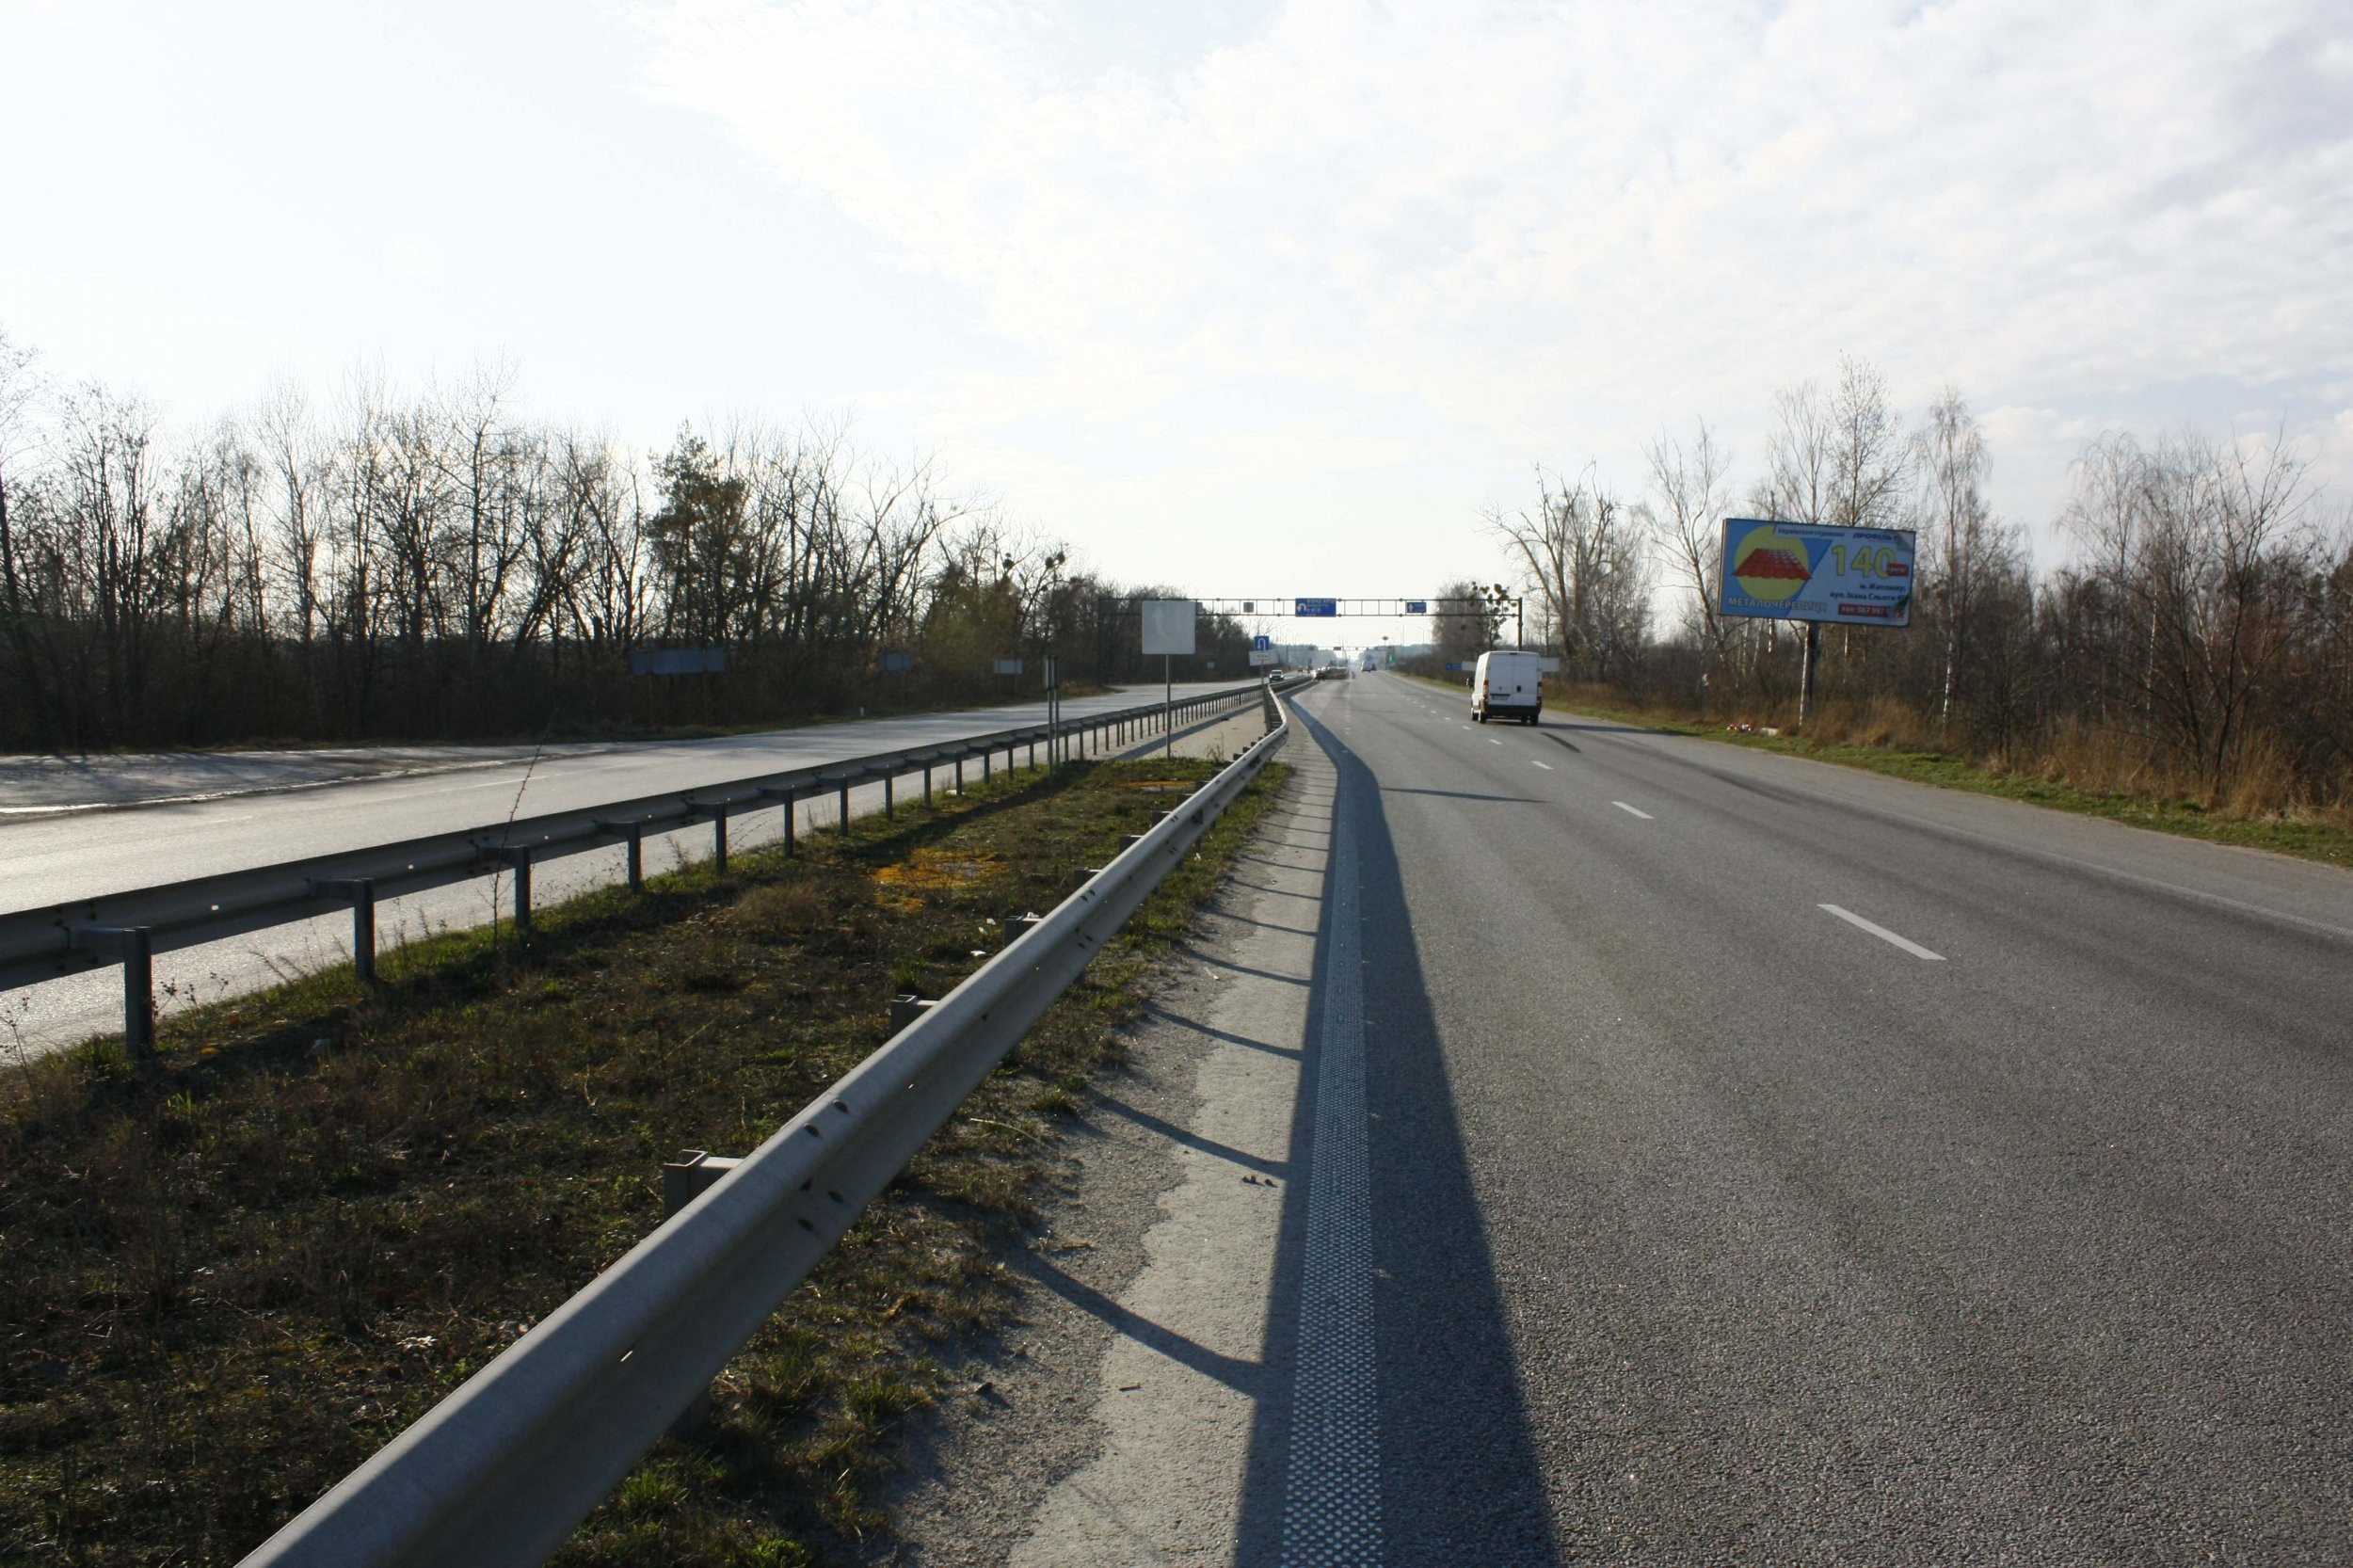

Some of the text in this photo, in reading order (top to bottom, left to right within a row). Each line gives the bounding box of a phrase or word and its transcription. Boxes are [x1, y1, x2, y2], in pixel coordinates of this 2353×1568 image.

[1831, 544, 1896, 580] 140
[1830, 591, 1845, 600] вул.
[1847, 591, 1866, 600] Івана
[1727, 597, 1828, 613] МЕТАЛОЧЕРЕПИЦЯ
